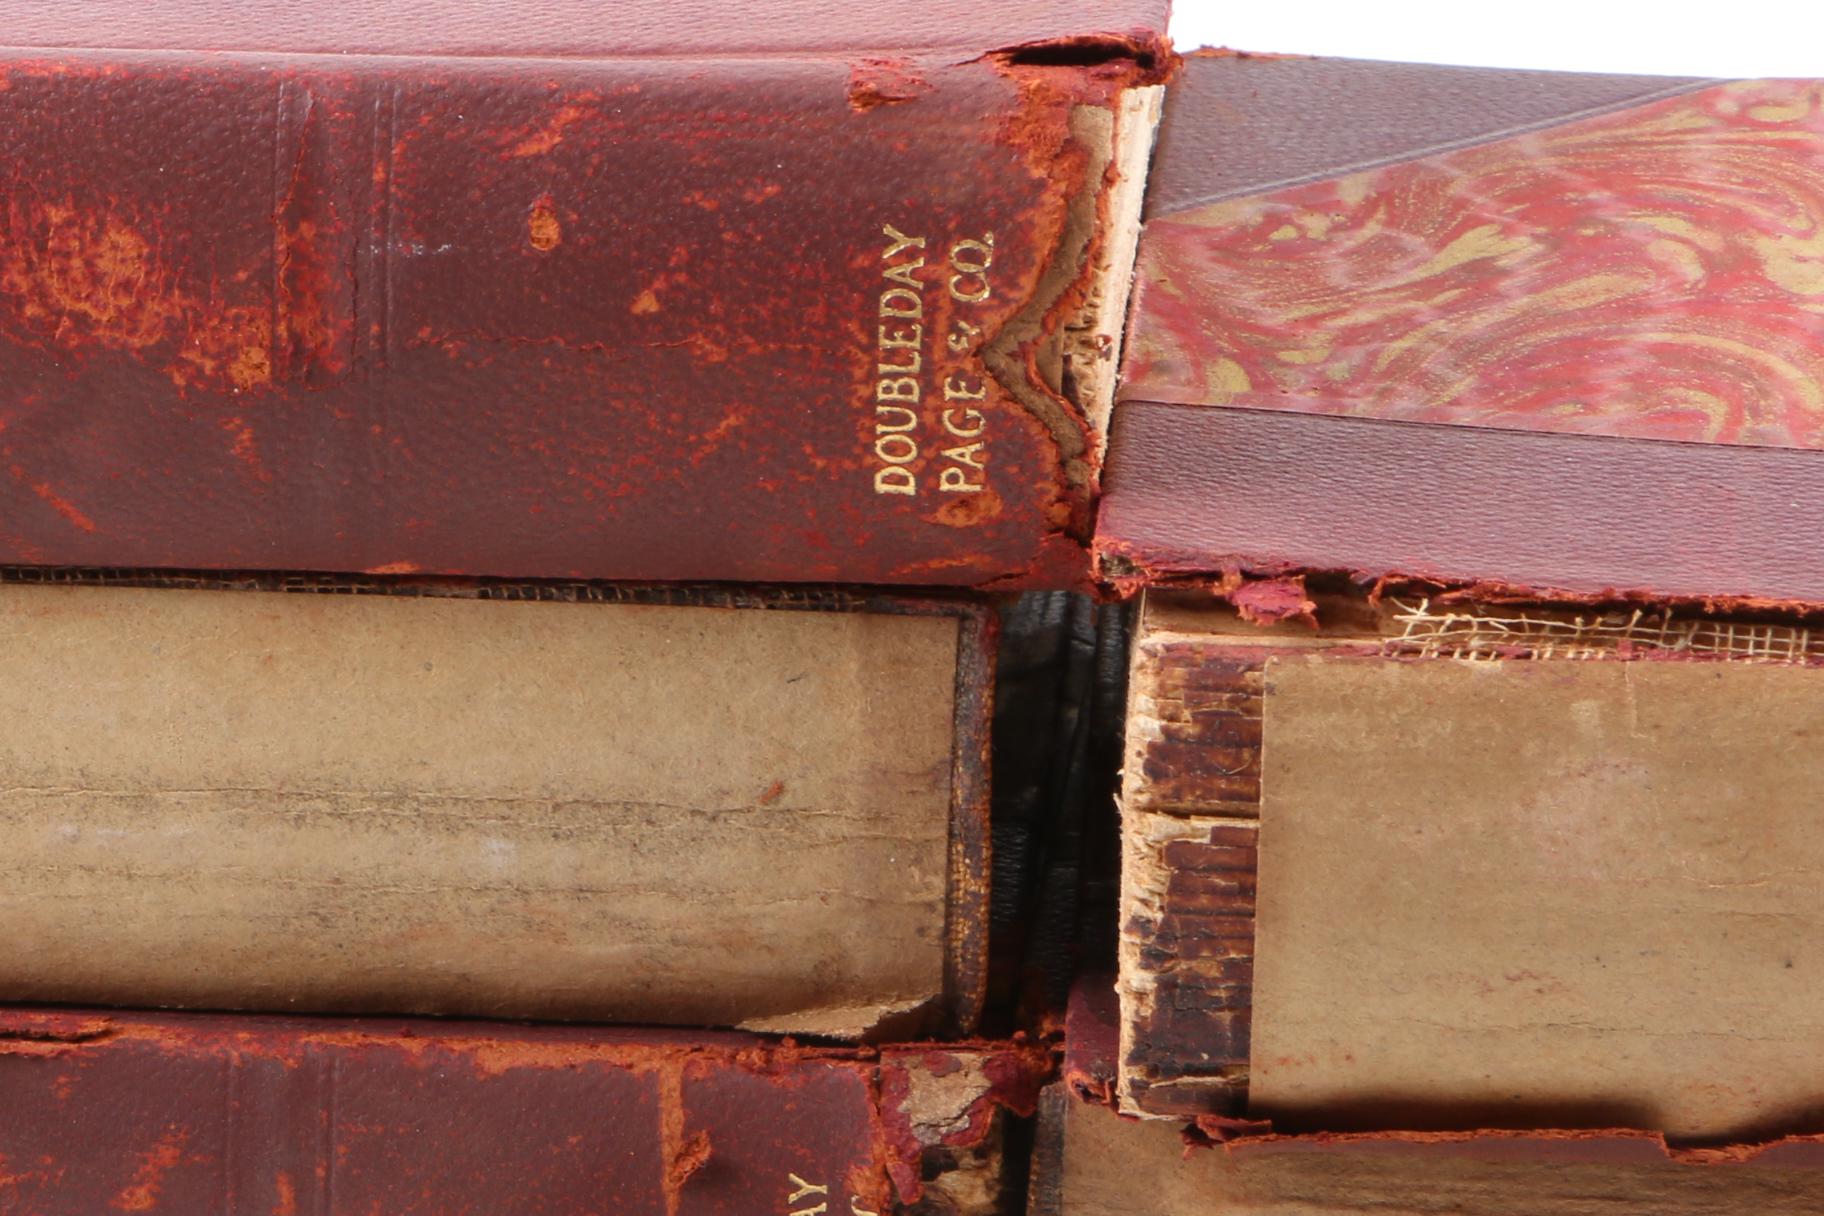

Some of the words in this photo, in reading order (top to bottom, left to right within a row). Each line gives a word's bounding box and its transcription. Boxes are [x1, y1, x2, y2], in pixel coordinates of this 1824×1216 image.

[949, 230, 994, 302] CO.
[873, 224, 926, 495] DOUBLEDAY
[948, 319, 980, 351] &
[939, 377, 986, 493] PAGE
